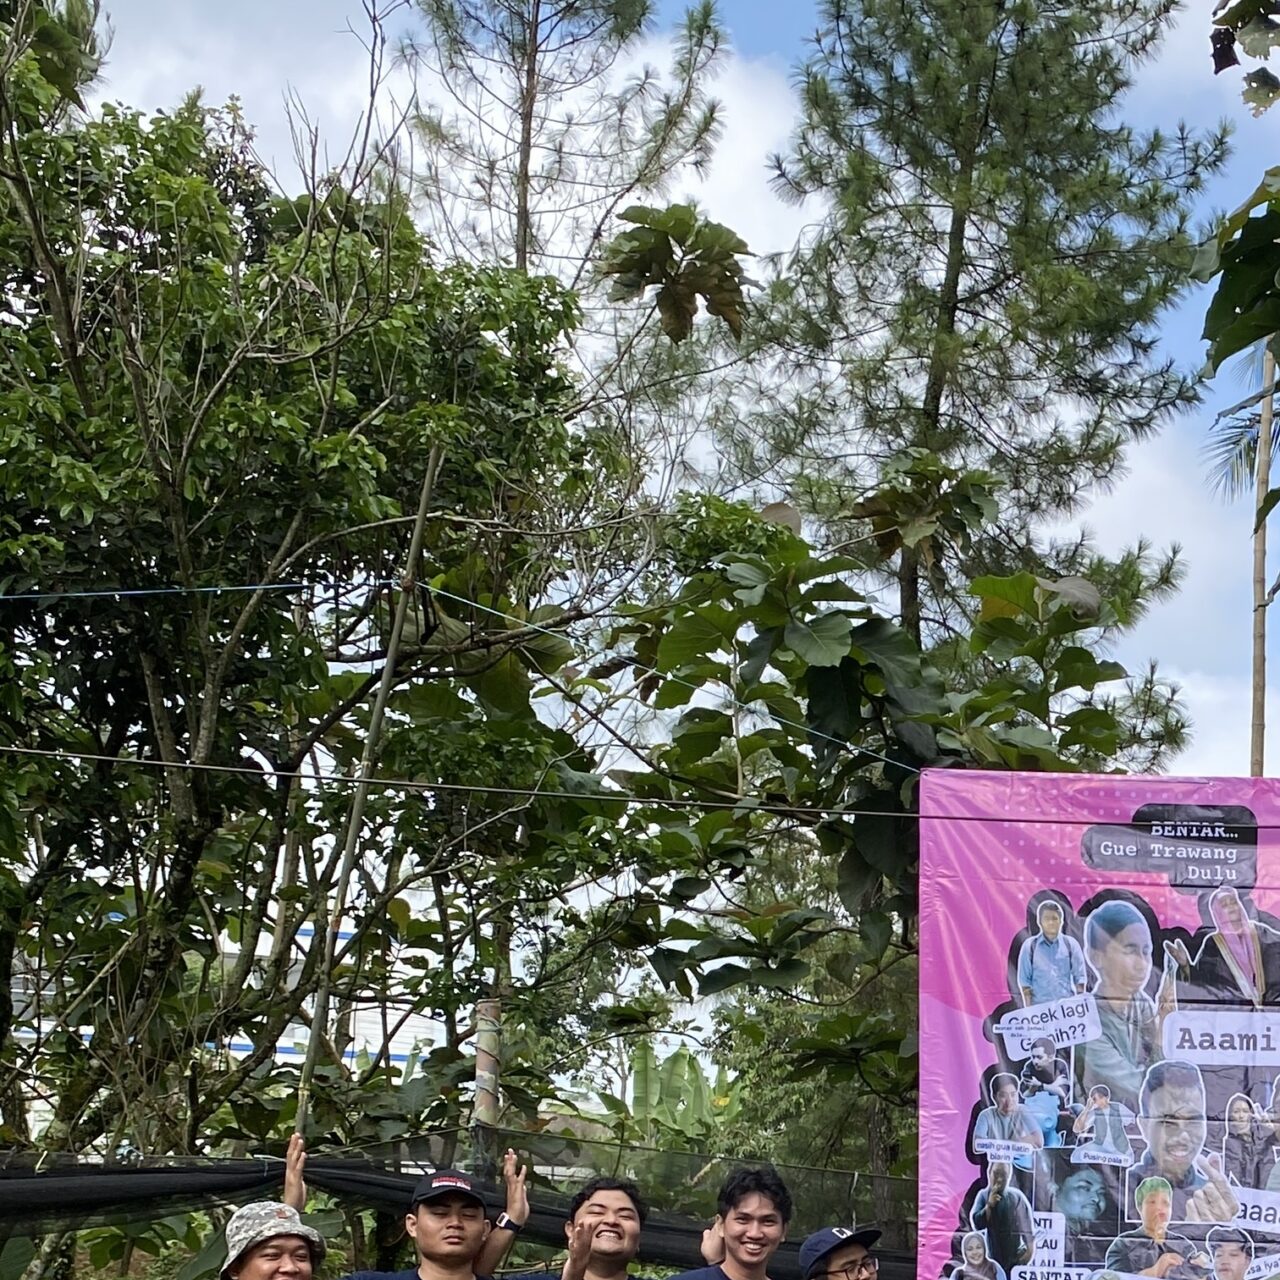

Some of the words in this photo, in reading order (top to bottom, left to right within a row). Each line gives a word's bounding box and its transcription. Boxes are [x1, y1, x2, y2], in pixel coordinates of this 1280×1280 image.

[1100, 841, 1138, 857] Gue
[1150, 843, 1239, 863] Trawang
[1187, 866, 1238, 880] Dulu
[1060, 998, 1090, 1018] lagi
